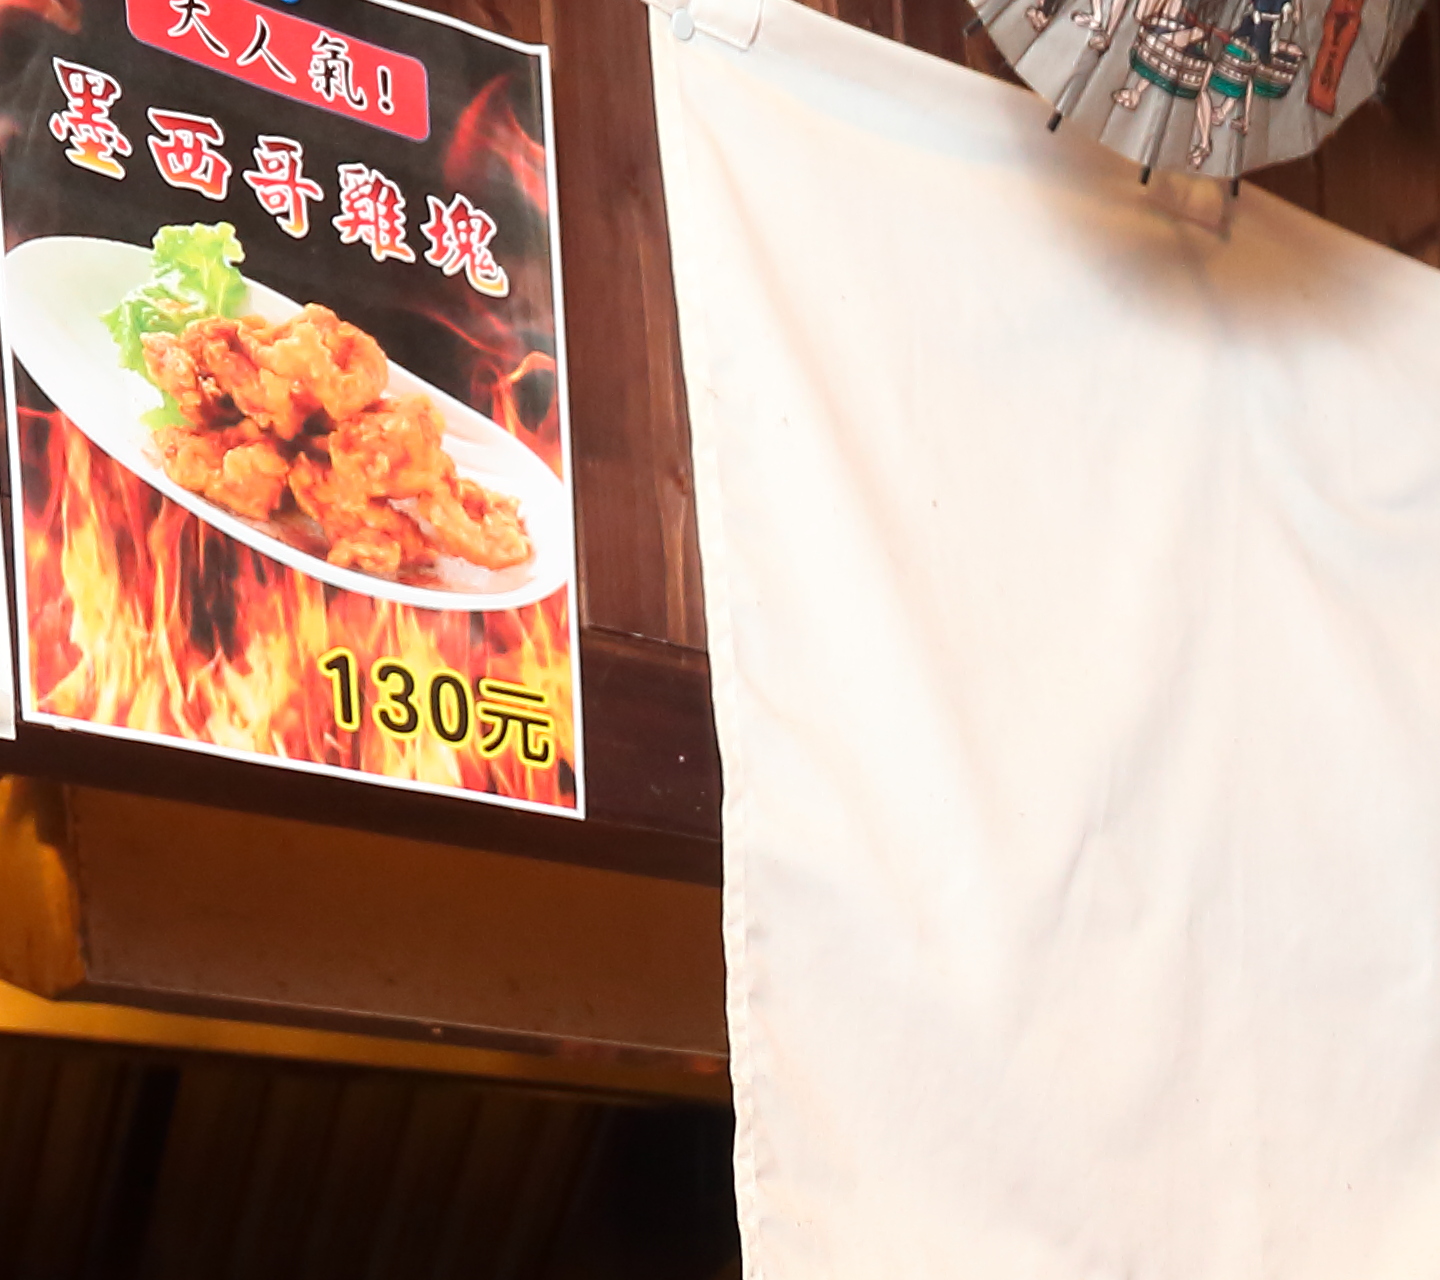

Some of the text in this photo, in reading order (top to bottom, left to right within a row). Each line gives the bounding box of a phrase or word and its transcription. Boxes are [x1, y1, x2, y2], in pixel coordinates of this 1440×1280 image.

[168, 0, 395, 114] 大人氣!
[48, 57, 509, 299] 墨西哥雞塊
[320, 645, 554, 766] 130元
